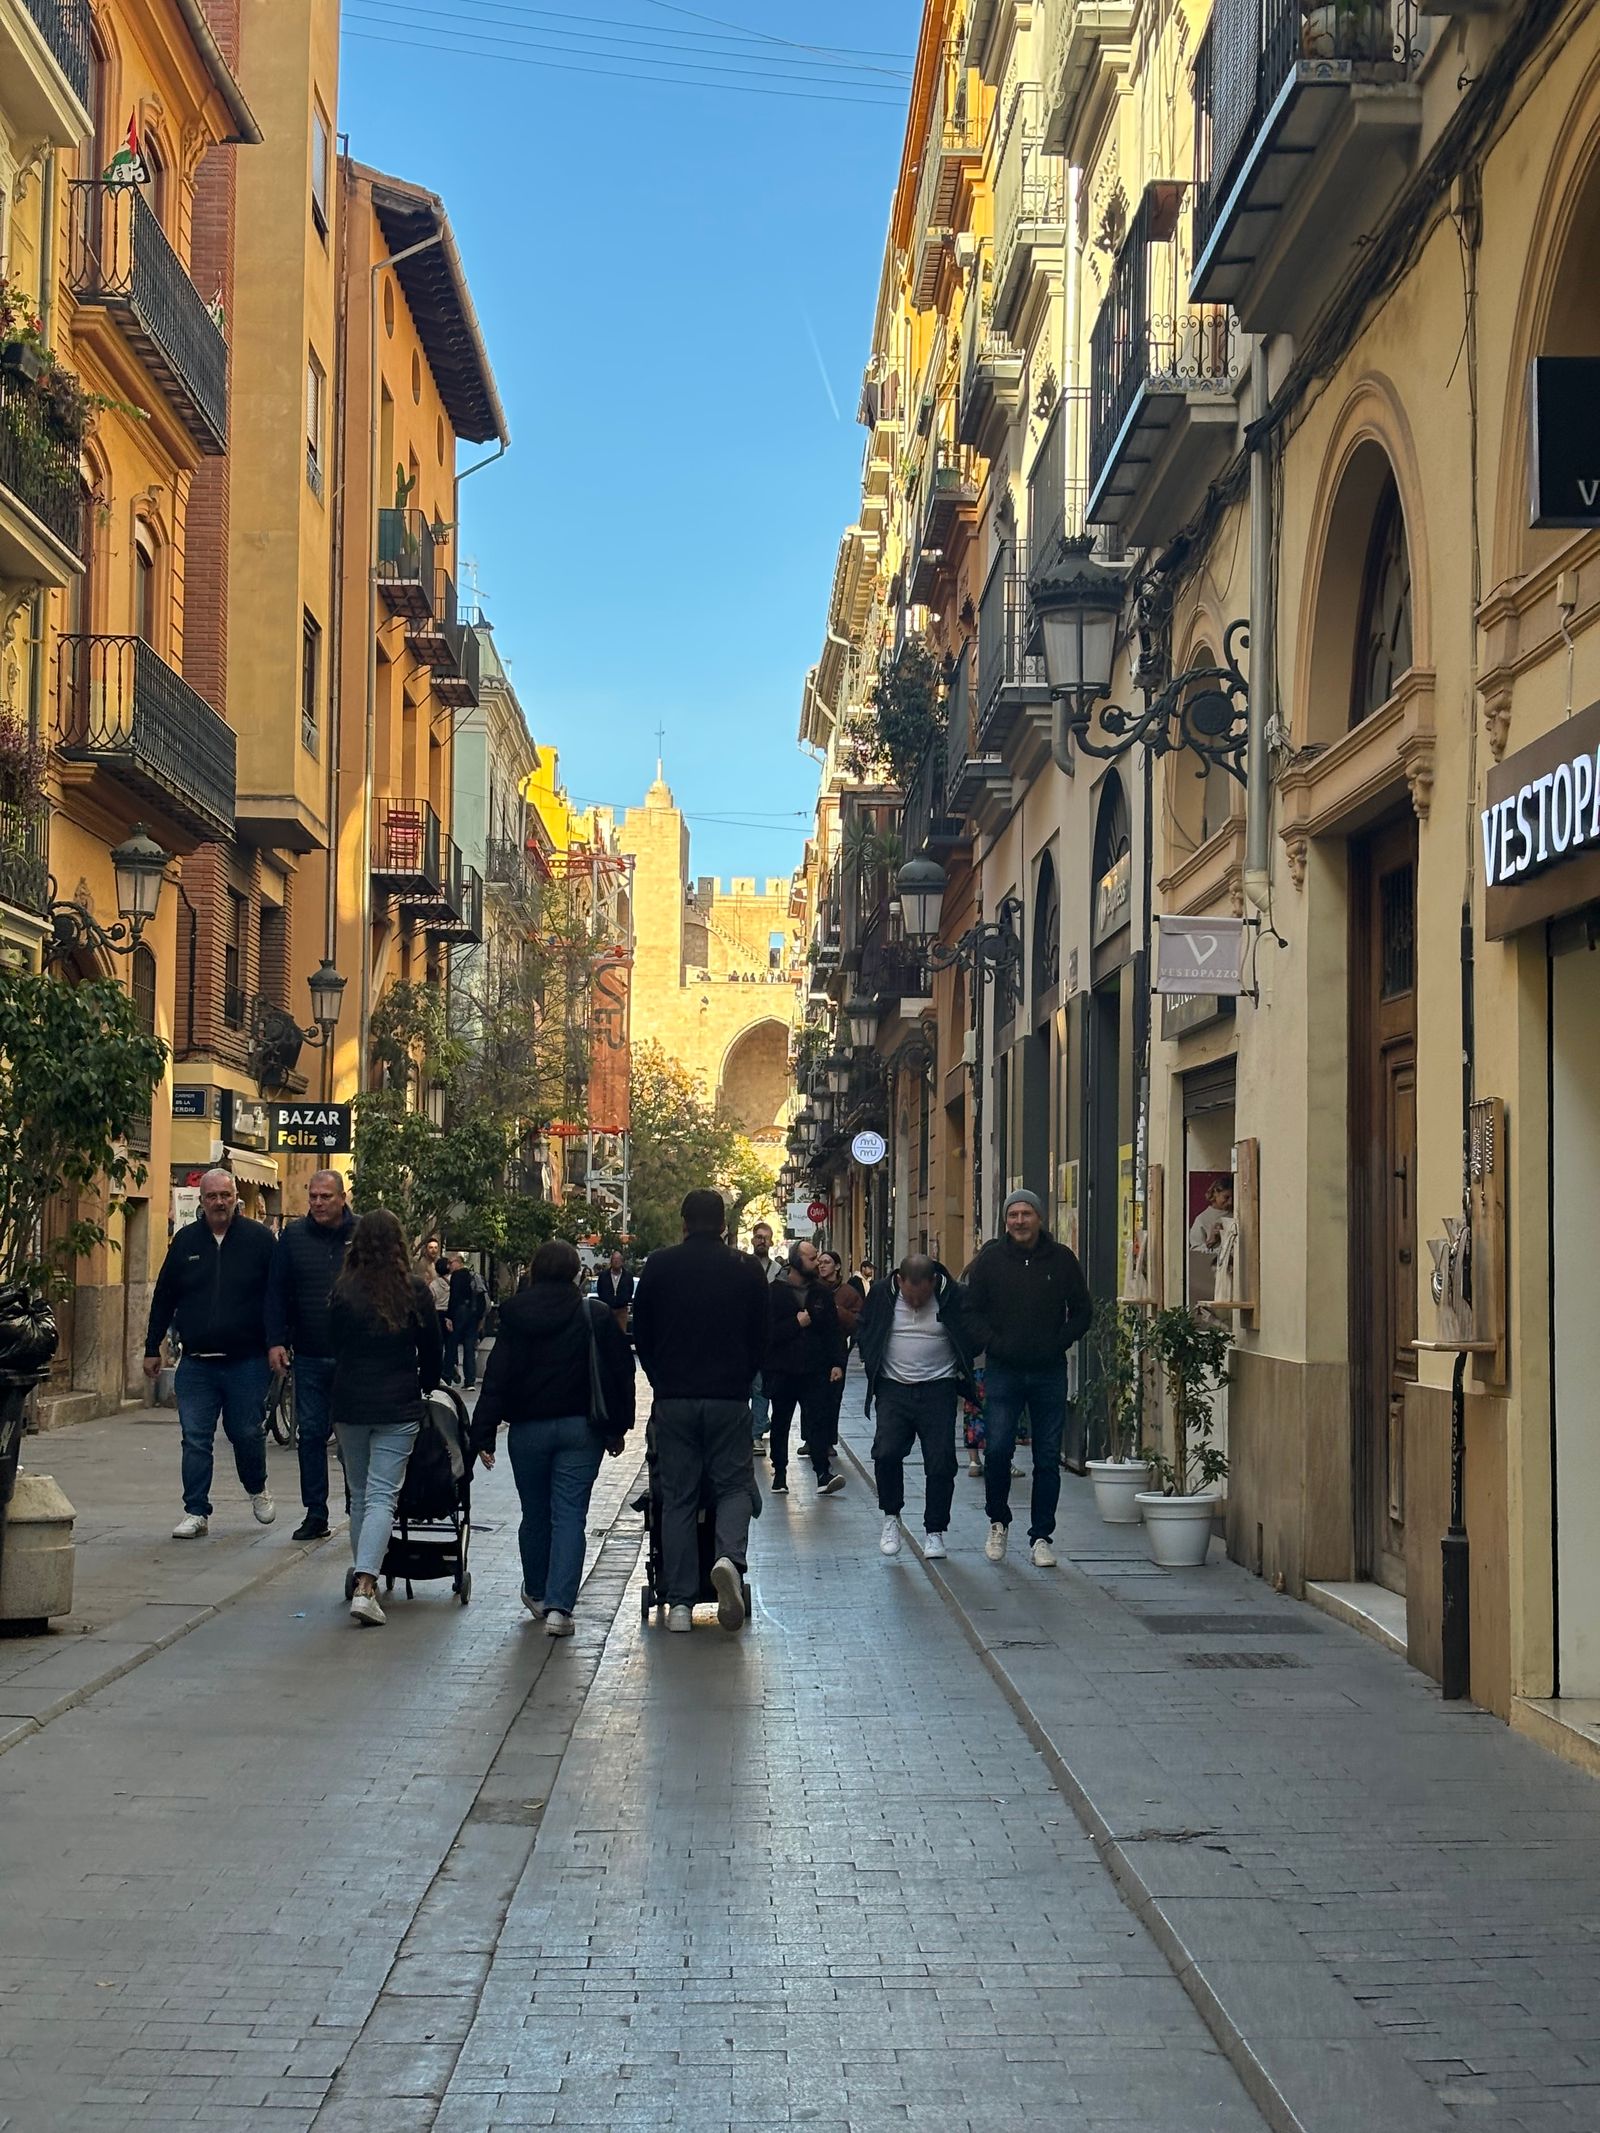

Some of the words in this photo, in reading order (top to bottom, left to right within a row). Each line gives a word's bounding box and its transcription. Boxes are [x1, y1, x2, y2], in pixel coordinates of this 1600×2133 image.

[1160, 967, 1239, 979] VESTOPAZZO
[278, 1110, 341, 1126] BAZAR
[277, 1130, 318, 1146] Feliz
